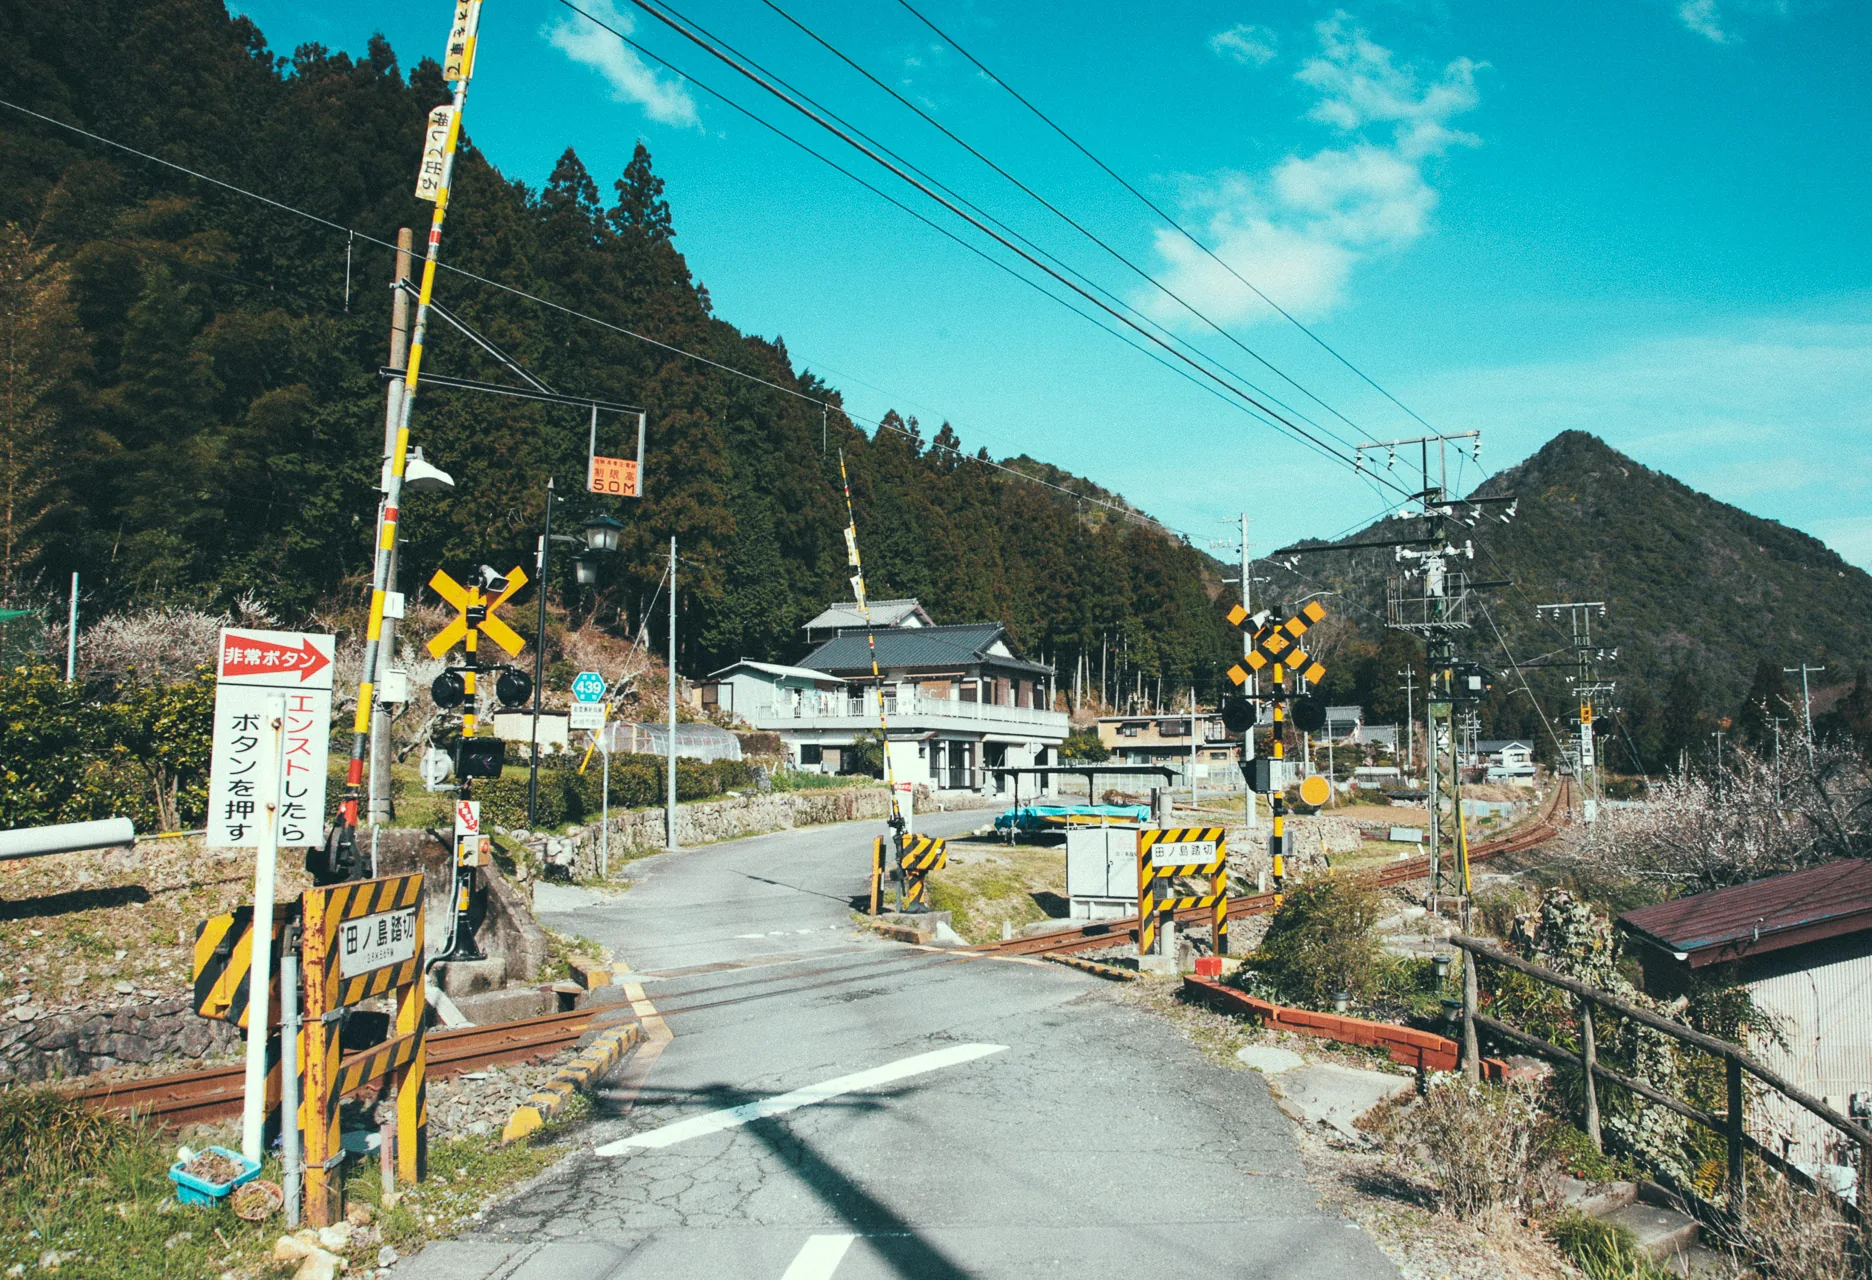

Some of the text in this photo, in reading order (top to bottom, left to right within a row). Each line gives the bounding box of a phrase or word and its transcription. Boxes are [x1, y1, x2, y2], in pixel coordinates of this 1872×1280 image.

[422, 111, 449, 190] 押して出る
[224, 647, 317, 669] 非常ボタン
[576, 681, 602, 694] 439
[224, 713, 261, 842] ボタンを押す
[281, 695, 314, 842] エンストしたら
[1155, 844, 1213, 858] 田ノ島踏切
[346, 912, 416, 956] 田ノ島踏切
